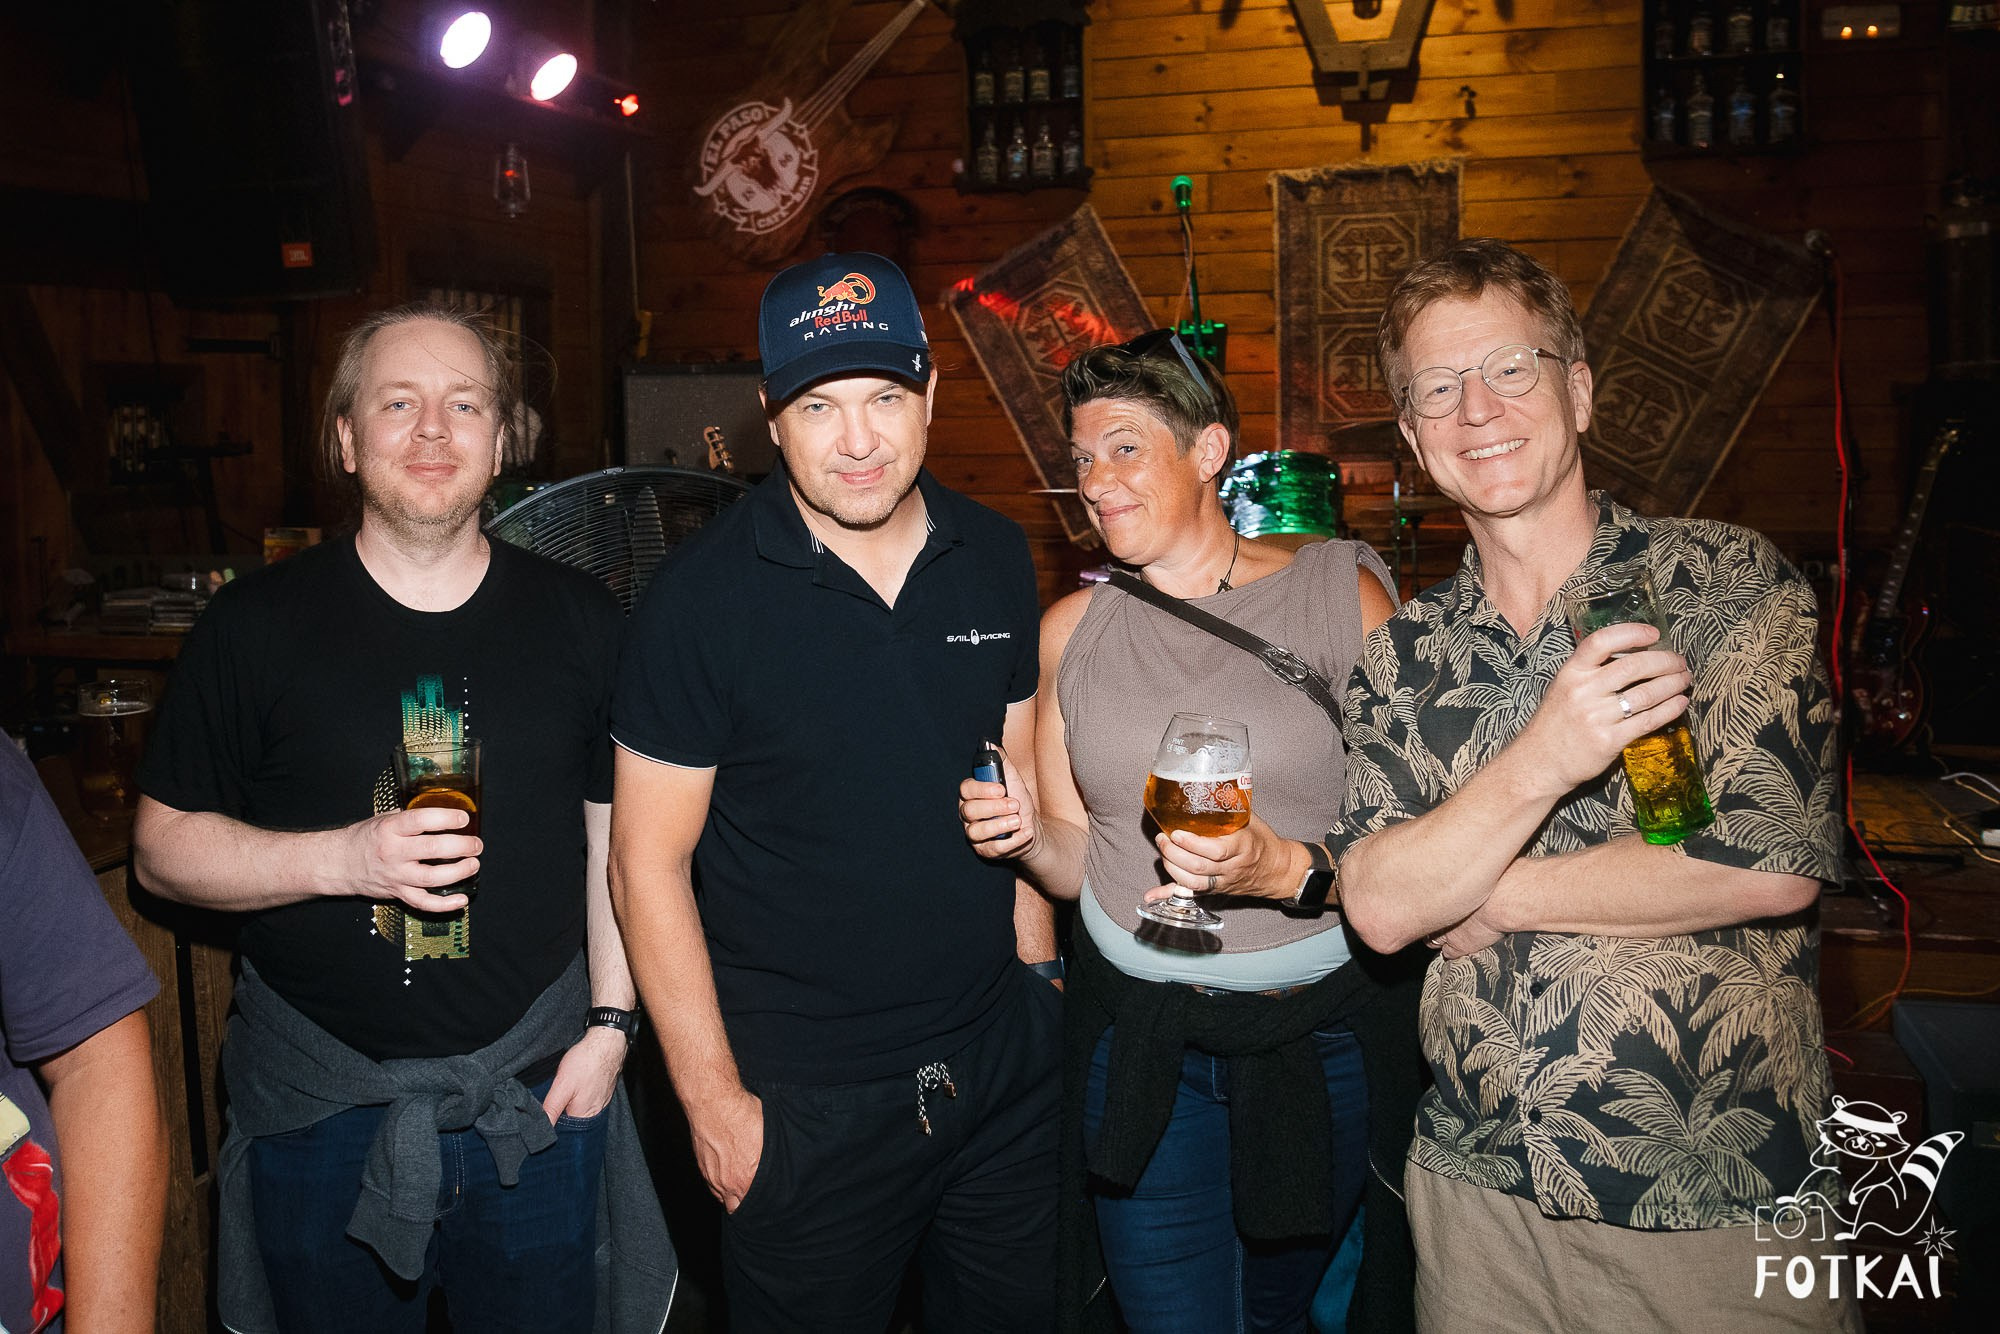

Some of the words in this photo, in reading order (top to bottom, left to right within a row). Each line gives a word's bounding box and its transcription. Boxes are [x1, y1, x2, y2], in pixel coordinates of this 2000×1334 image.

[705, 139, 724, 166] EL
[718, 107, 763, 140] PASO
[789, 300, 856, 328] alinghi
[814, 312, 841, 328] Red
[842, 309, 868, 323] Bull
[803, 321, 889, 341] RACING
[946, 635, 970, 643] SAIL
[980, 632, 1011, 641] RACING
